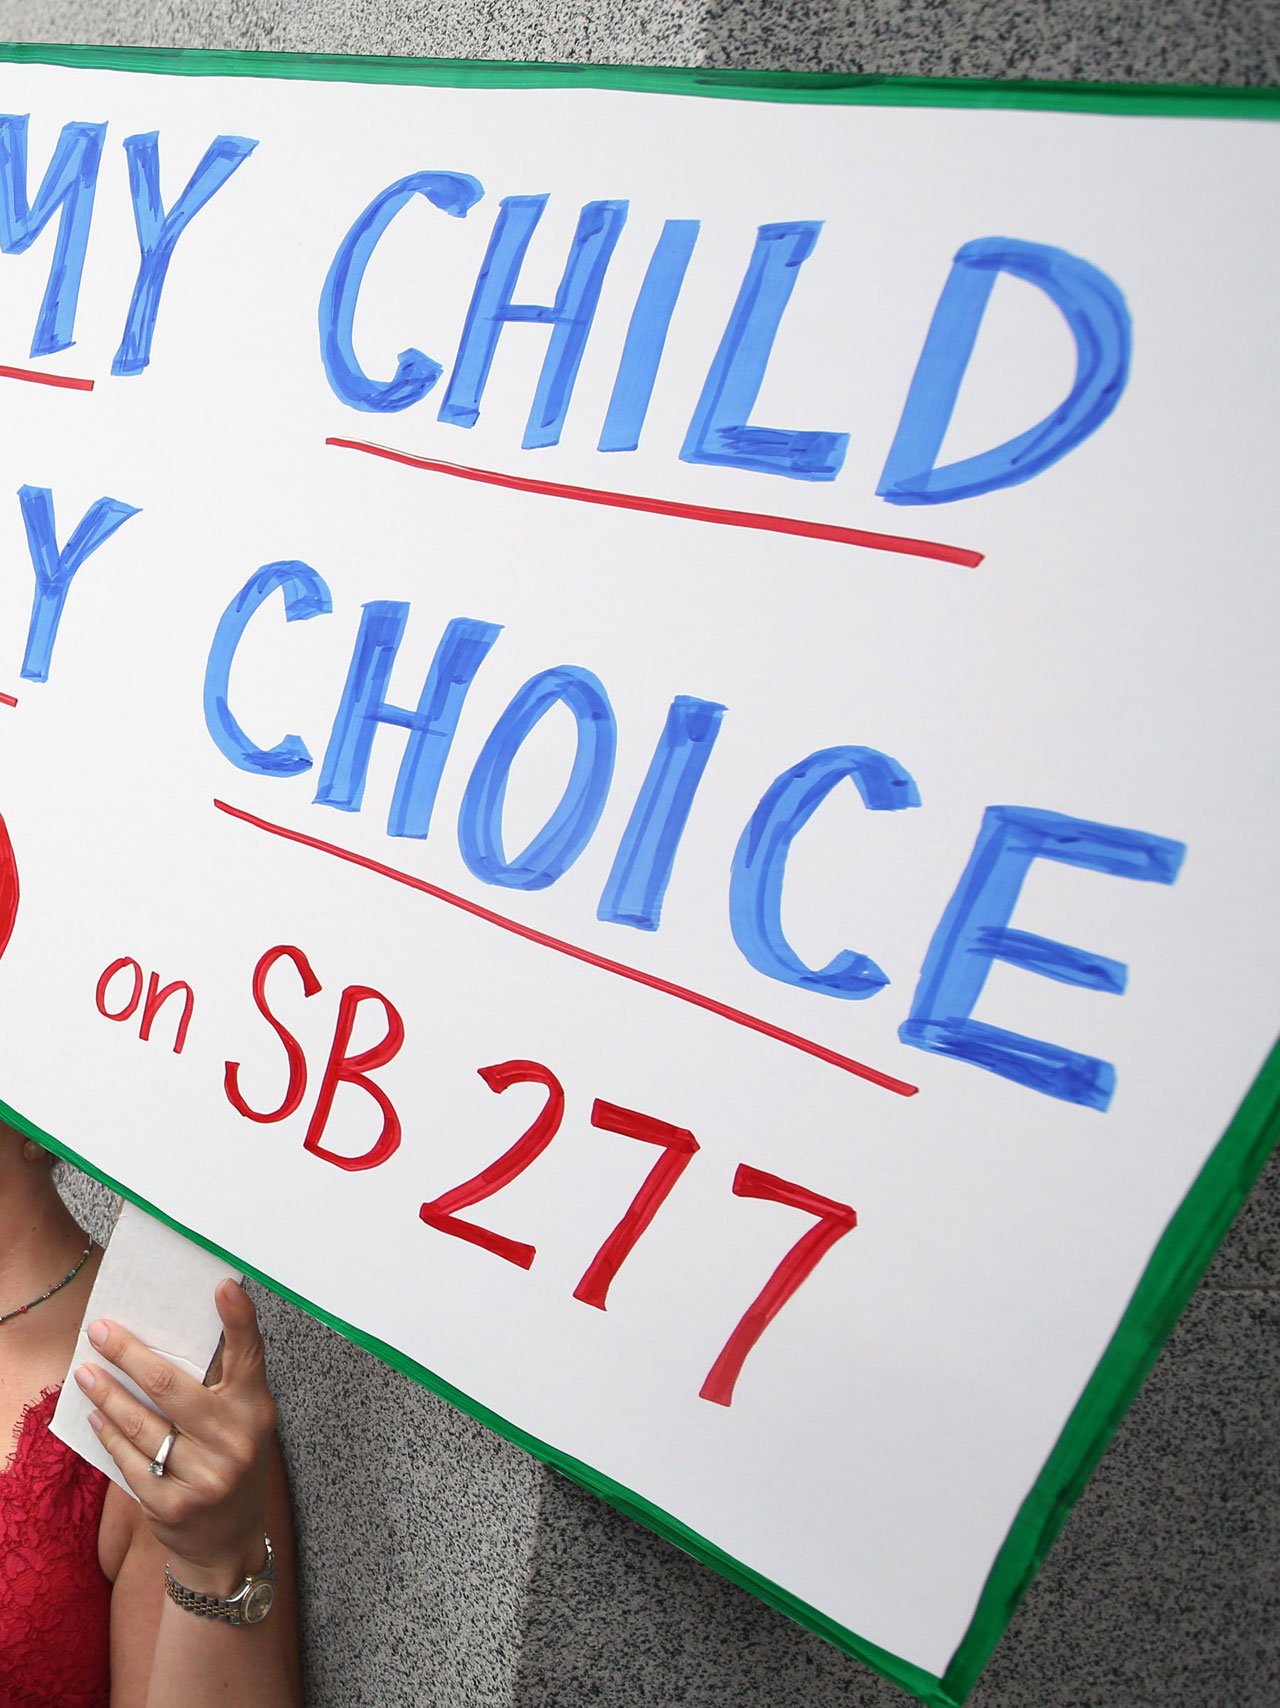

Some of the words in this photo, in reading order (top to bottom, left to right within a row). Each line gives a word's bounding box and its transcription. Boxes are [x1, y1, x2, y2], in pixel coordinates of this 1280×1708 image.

[318, 170, 1133, 506] CHILD
[203, 559, 1187, 1113] CHOICE
[95, 956, 194, 1054] on
